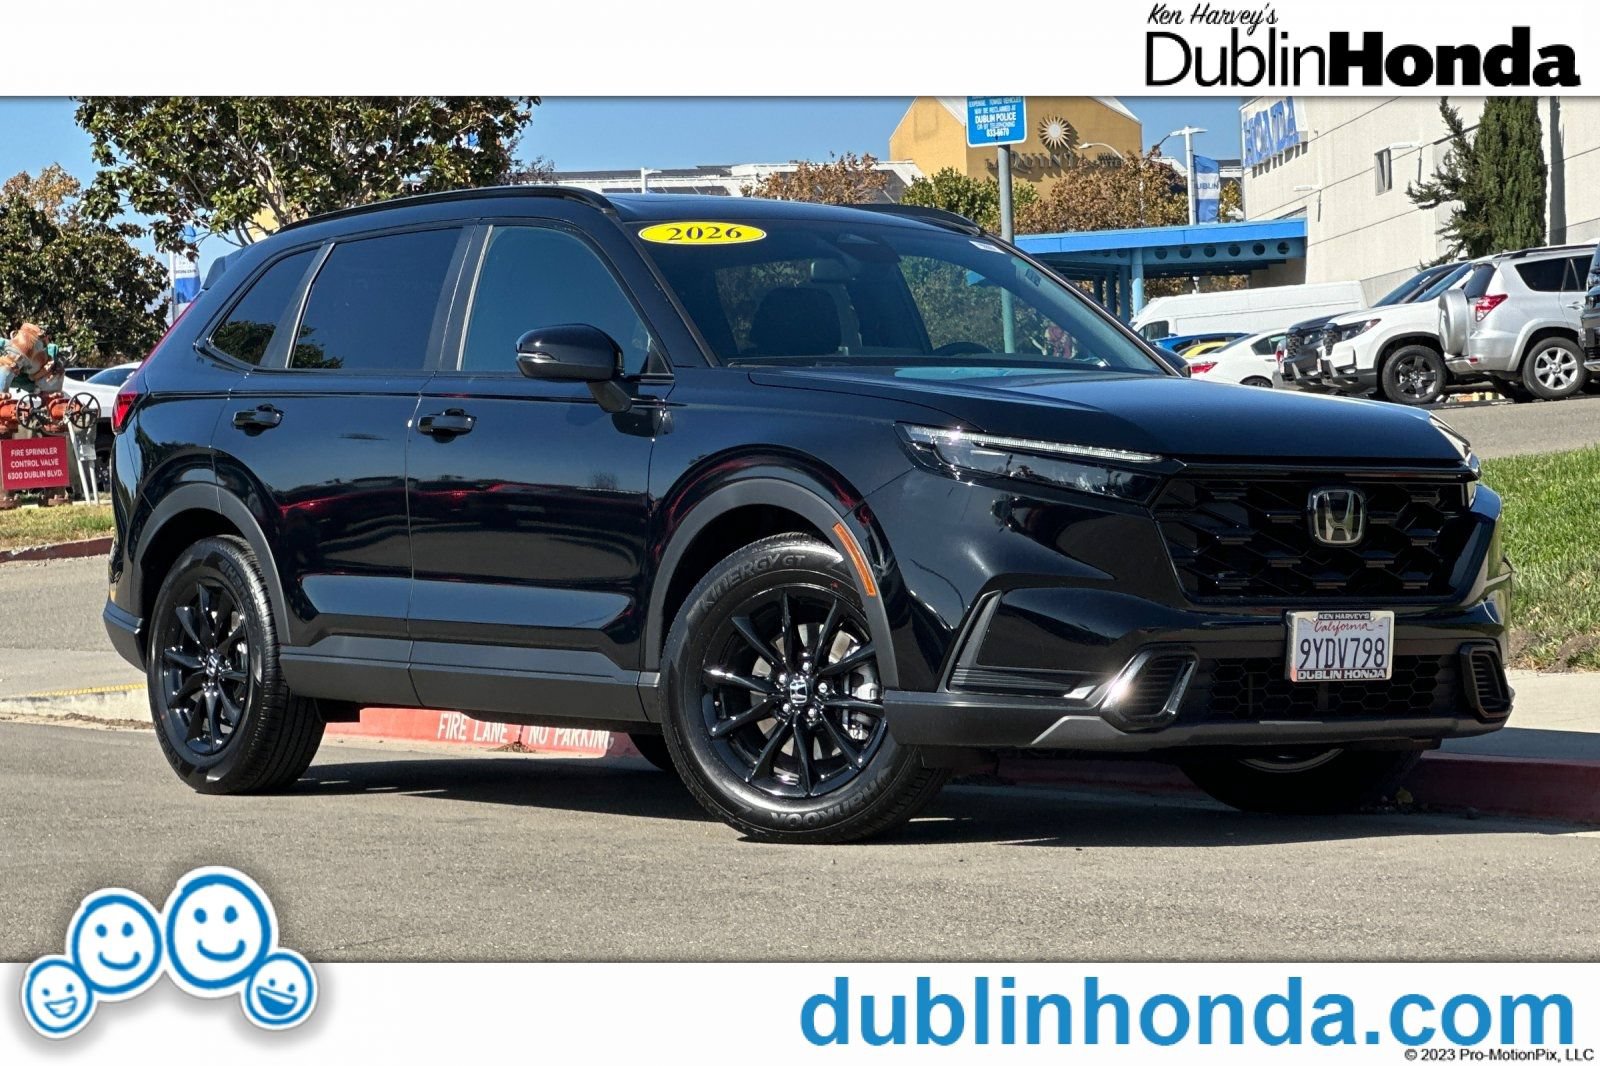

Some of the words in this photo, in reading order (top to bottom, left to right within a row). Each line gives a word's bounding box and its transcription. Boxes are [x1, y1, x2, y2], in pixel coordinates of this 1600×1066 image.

[975, 114, 995, 124] DUBLIN
[996, 111, 1016, 121] POLICE
[1244, 95, 1300, 168] HONDA
[666, 226, 743, 241] 2026
[10, 449, 25, 457] FIRE
[25, 447, 58, 456] SPRINKLER
[10, 460, 40, 469] CONTROL
[40, 458, 59, 467] VALVE
[7, 472, 23, 480] 6300
[23, 470, 46, 480] DUBLIN
[46, 469, 64, 478] BLVD.
[781, 555, 806, 567] GT
[1334, 612, 1370, 620] HARVEY'S
[1314, 620, 1375, 636] California
[1299, 637, 1385, 669] 9YDV798
[1297, 669, 1342, 680] DUBLIN
[1344, 669, 1386, 680] HONDA
[437, 713, 471, 741] FIRE
[473, 721, 508, 743] LANE
